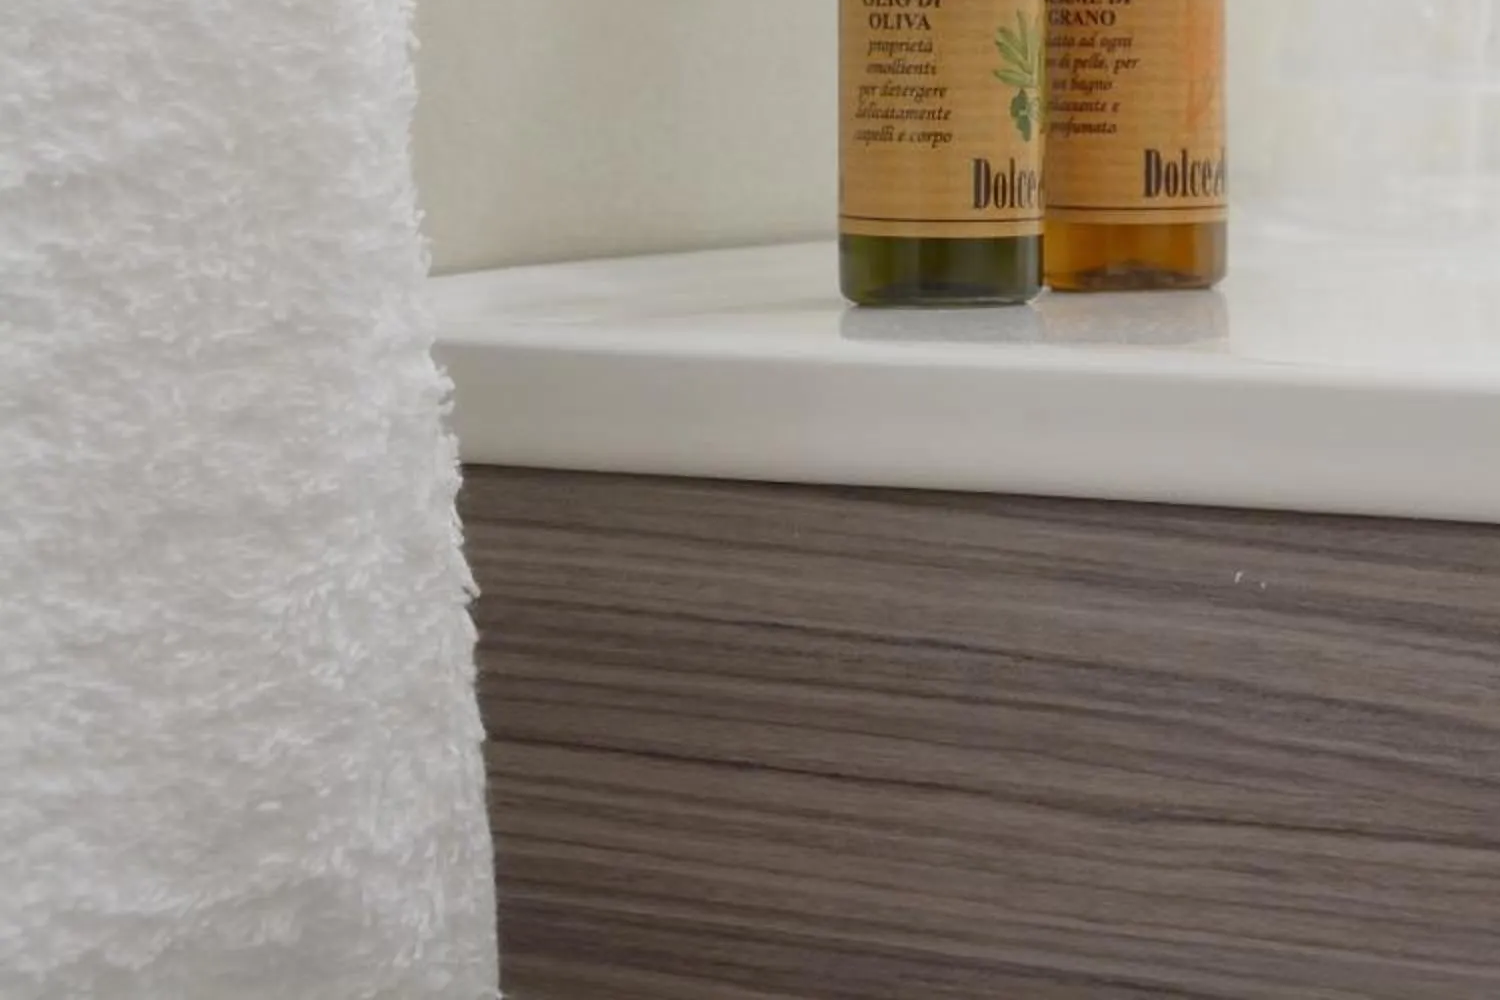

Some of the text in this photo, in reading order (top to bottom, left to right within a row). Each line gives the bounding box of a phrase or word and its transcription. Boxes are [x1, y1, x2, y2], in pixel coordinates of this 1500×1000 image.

[868, 12, 931, 30] OLIVA
[1048, 9, 1116, 26] GRANO
[1113, 56, 1141, 74] per
[909, 130, 953, 148] corpo
